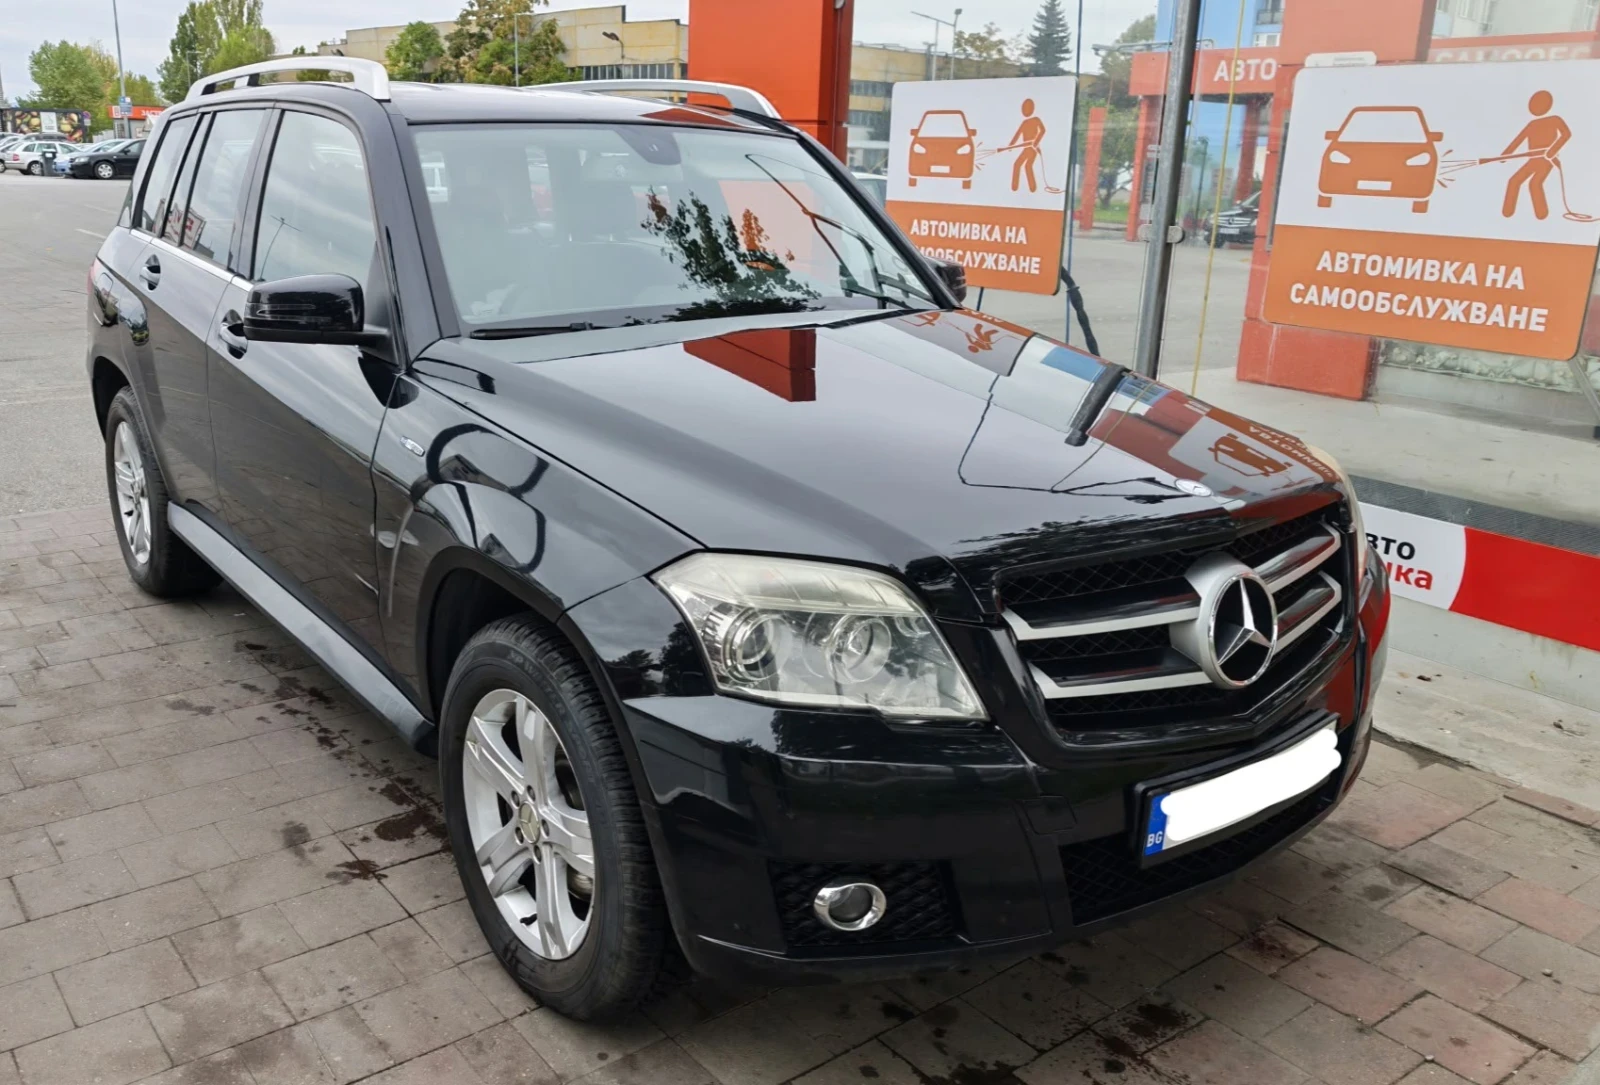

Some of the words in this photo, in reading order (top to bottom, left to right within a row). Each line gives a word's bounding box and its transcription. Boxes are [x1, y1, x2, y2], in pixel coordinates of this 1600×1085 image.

[910, 219, 1002, 243] АВТОМИВКА
[1005, 226, 1027, 245] НА
[1316, 250, 1478, 286] АВТОМИВКА
[1485, 264, 1525, 290] НА
[1290, 283, 1549, 332] САМООБСЛУЖВАНЕ
[1146, 831, 1163, 848] BG
